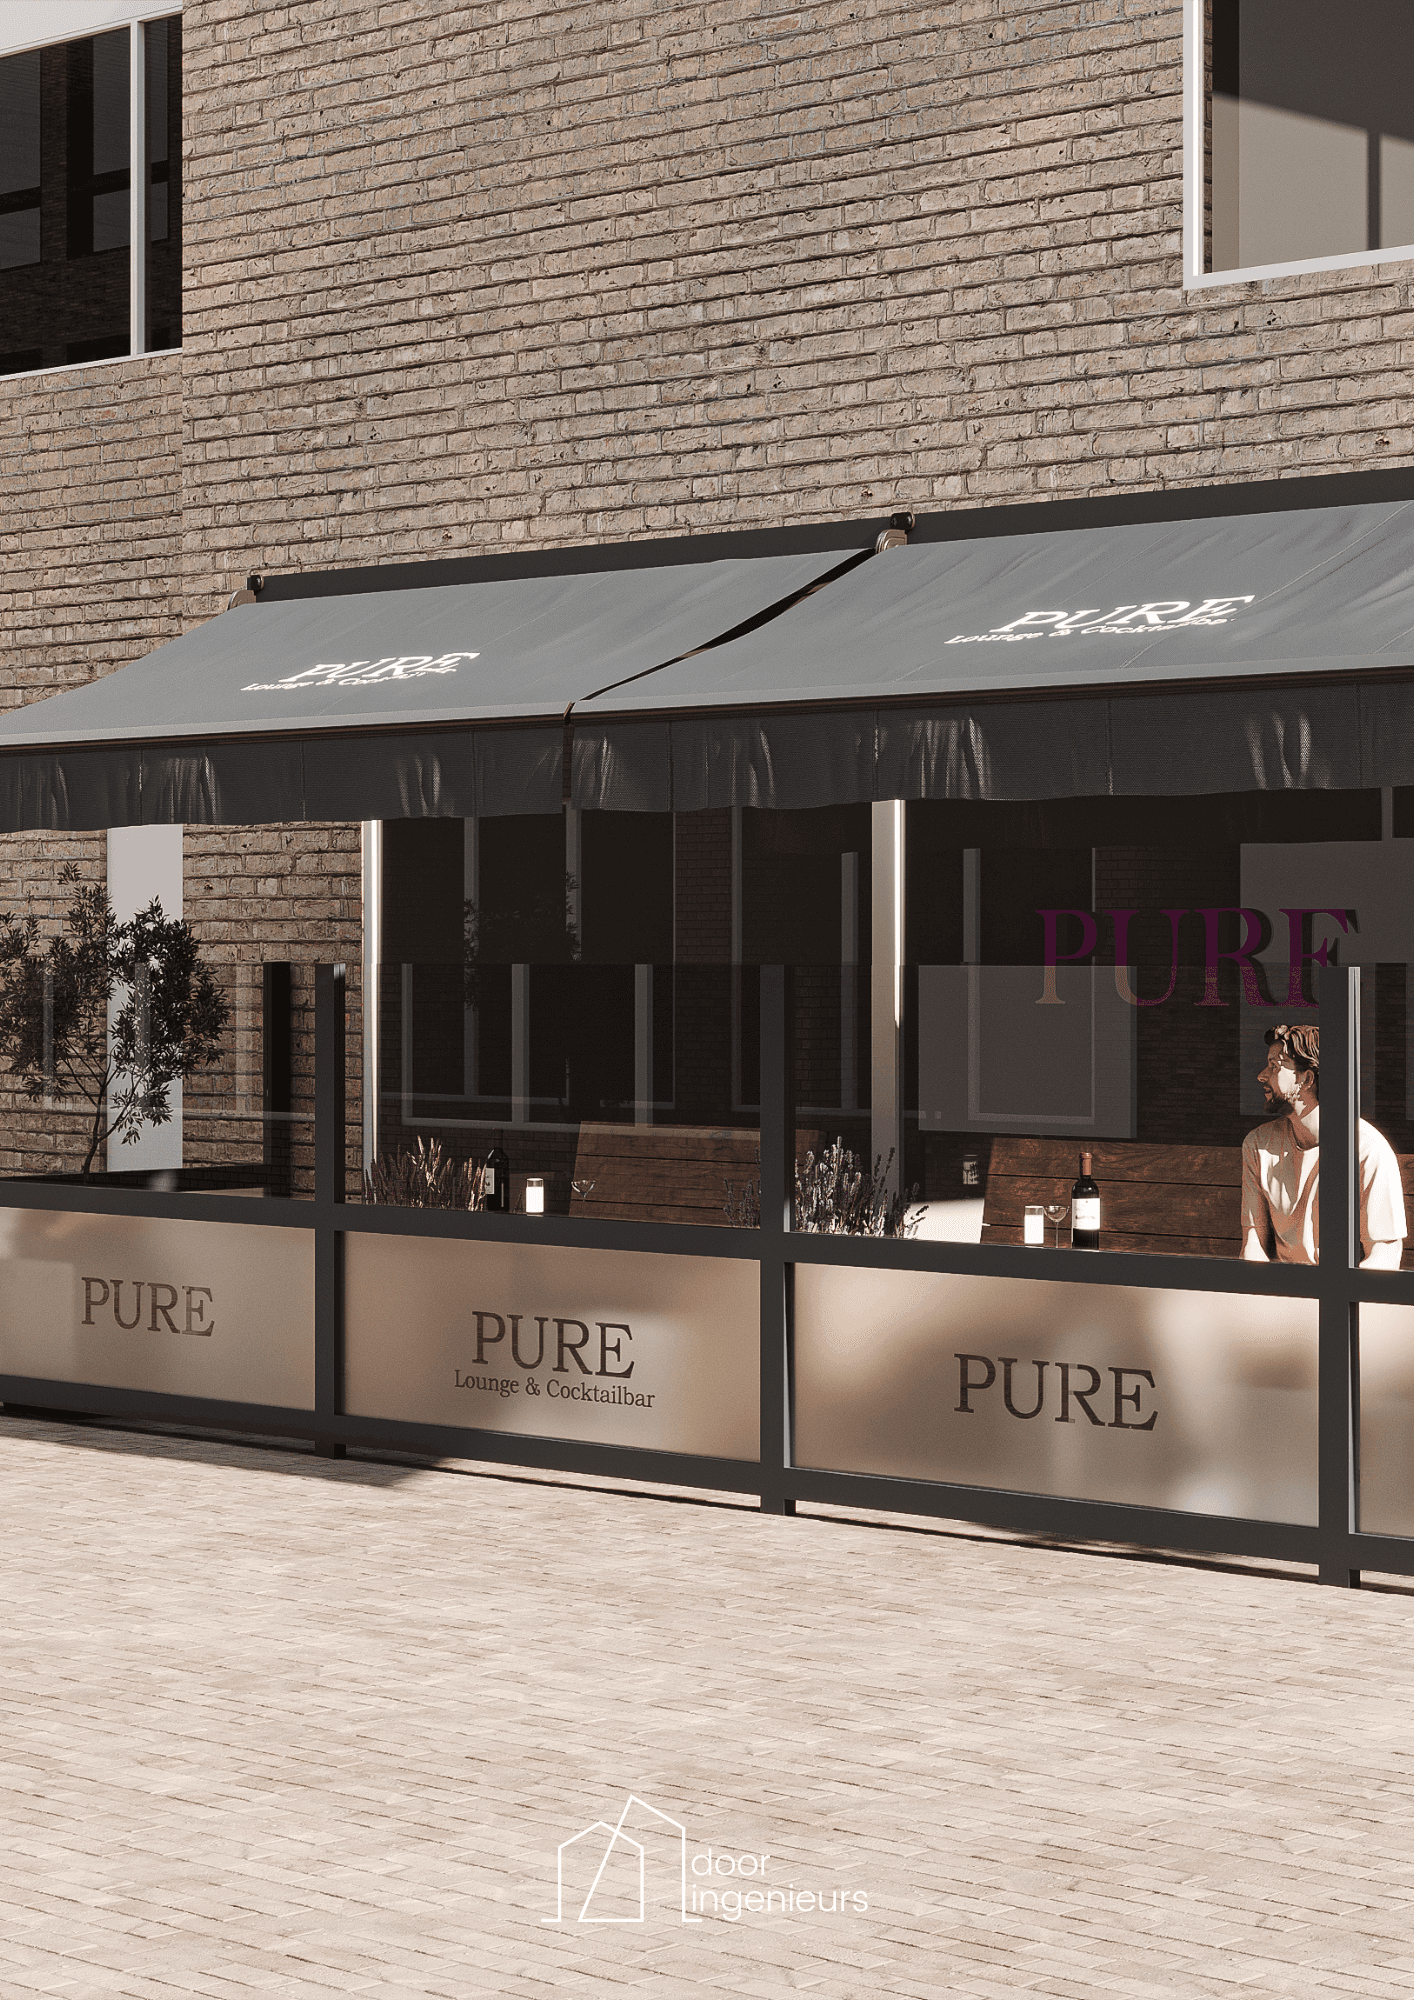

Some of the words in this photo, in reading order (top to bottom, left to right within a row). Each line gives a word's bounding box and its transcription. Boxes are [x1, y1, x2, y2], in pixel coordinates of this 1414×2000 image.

[988, 595, 1255, 632] PURE
[277, 652, 481, 682] PURE
[1035, 907, 1355, 1008] PURE
[81, 1276, 215, 1337] PURE
[471, 1310, 635, 1379] PURE
[454, 1369, 520, 1398] Lounge
[525, 1376, 541, 1396] &
[546, 1378, 656, 1408] Cocktailbar
[953, 1353, 1159, 1431] PURE
